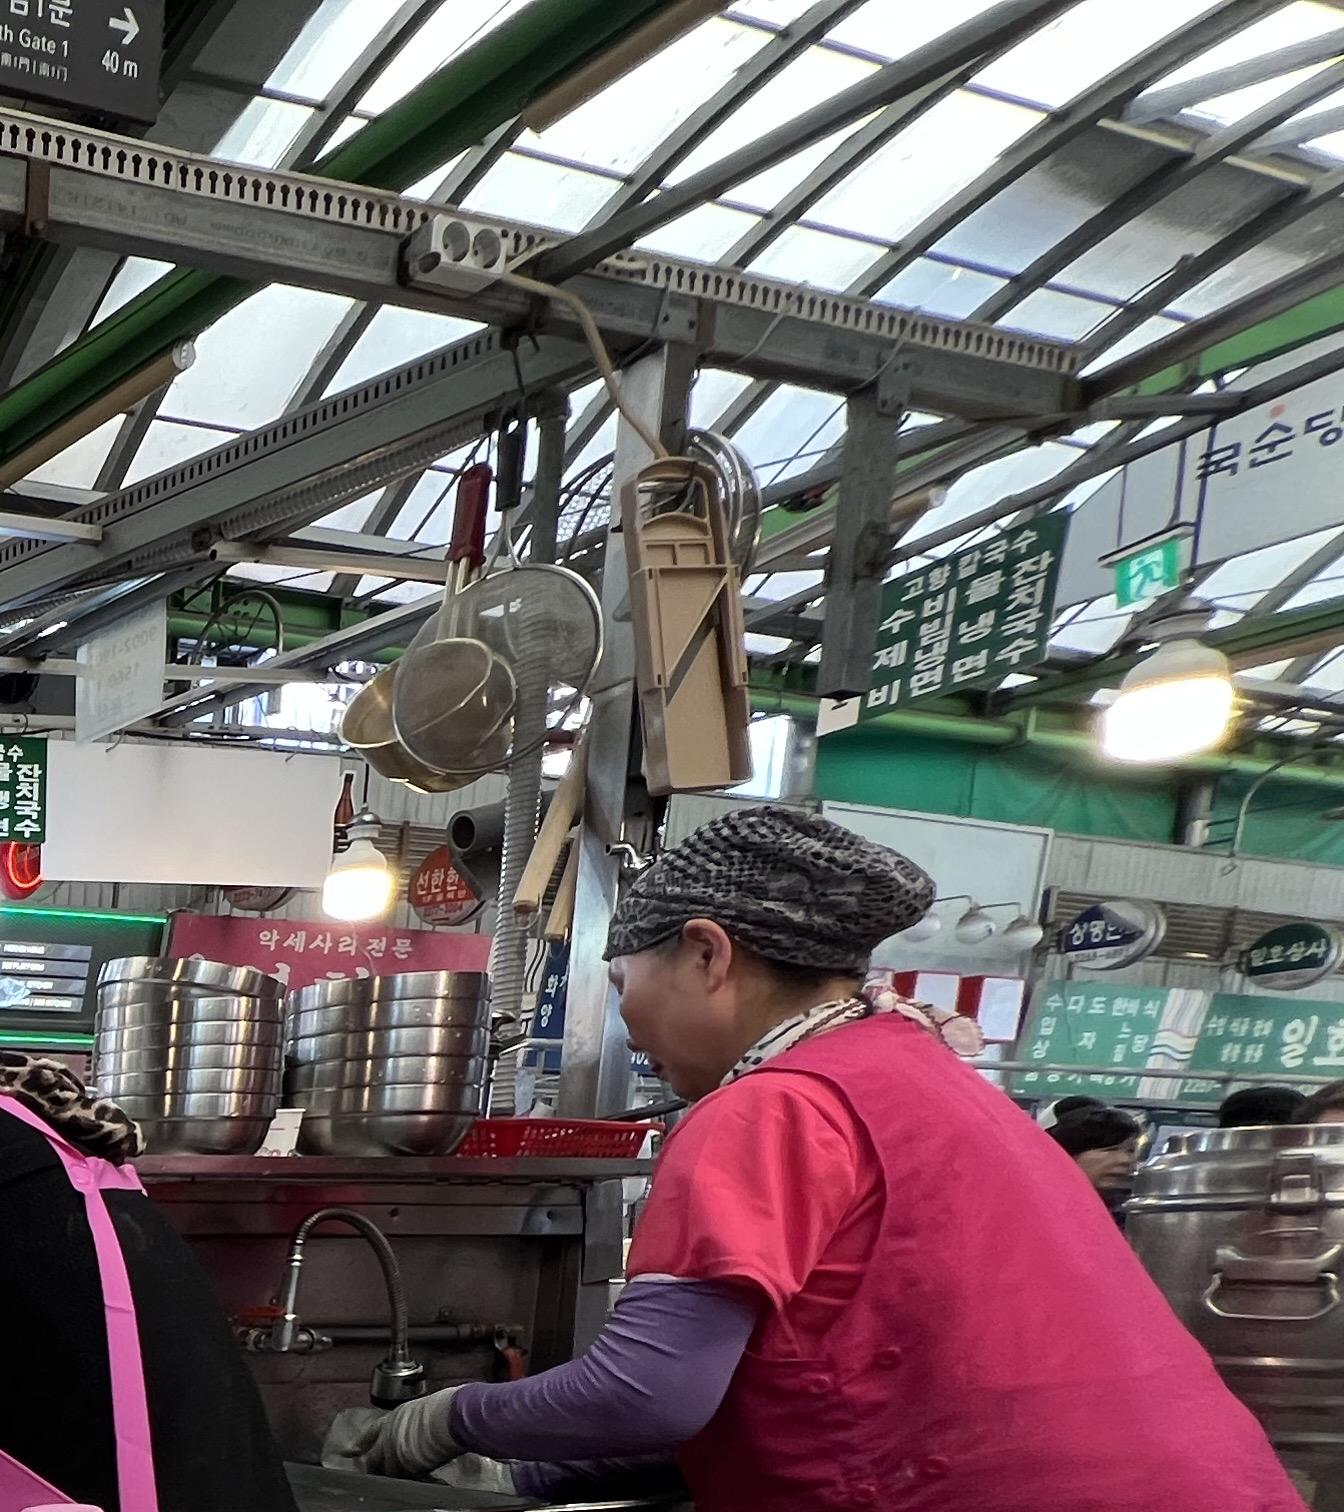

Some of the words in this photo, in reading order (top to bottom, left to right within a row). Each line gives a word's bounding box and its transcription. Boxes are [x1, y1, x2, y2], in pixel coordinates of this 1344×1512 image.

[18, 28, 57, 55] Gate
[61, 40, 69, 58] 1
[101, 49, 120, 74] 40
[123, 60, 139, 79] m
[994, 549, 1056, 666] 잔치국수
[866, 608, 916, 709] 수제비
[13, 763, 43, 839] 잔치국수
[258, 929, 360, 956] 악세사리
[366, 937, 413, 960] 전문
